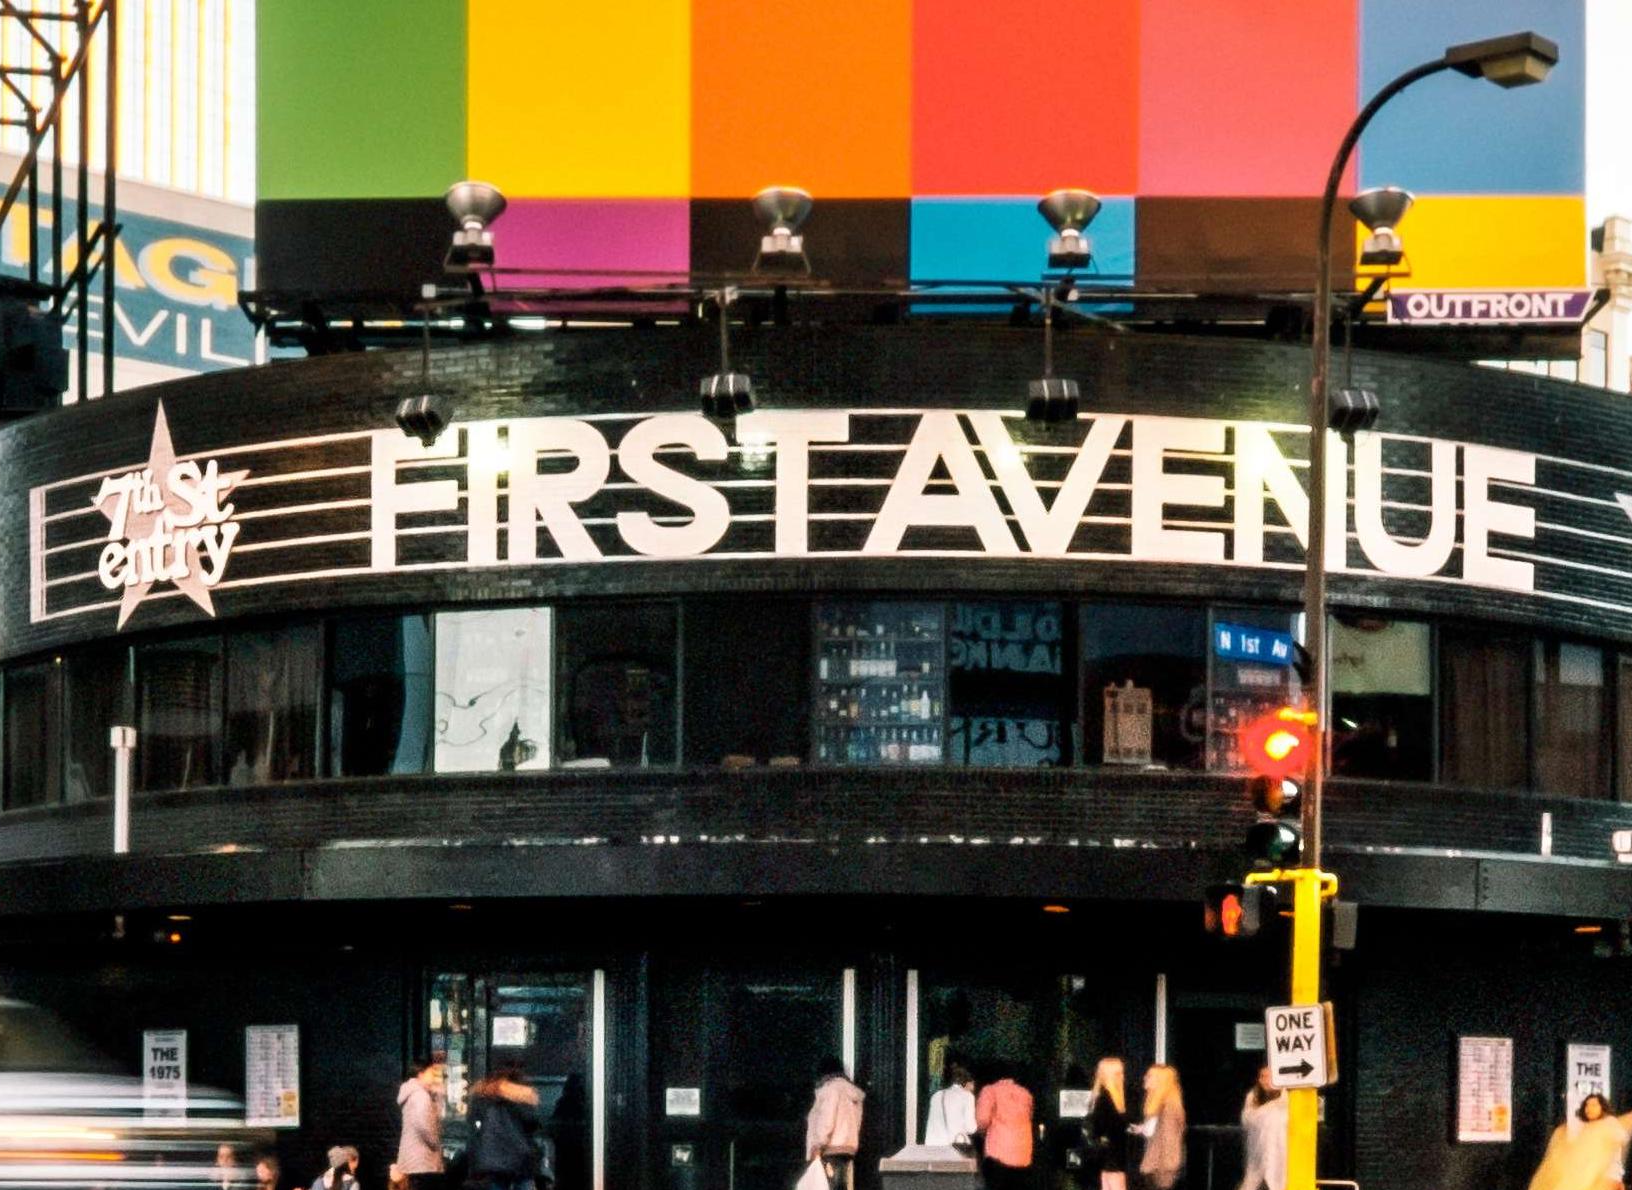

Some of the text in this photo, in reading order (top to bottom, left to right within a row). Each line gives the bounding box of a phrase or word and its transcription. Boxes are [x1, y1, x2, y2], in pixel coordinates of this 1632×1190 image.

[1406, 293, 1574, 318] OUTFRONT
[91, 459, 235, 540] 7th St
[369, 410, 849, 570] FIRST
[862, 412, 1536, 592] AVENUE
[98, 512, 240, 589] entry
[1220, 630, 1232, 651] N
[1272, 639, 1288, 658] Av
[1275, 1011, 1315, 1032] ONE
[151, 1047, 179, 1062] THE
[1275, 1033, 1316, 1054] WAY
[149, 1065, 181, 1080] 1975
[1576, 1062, 1602, 1077] THE
